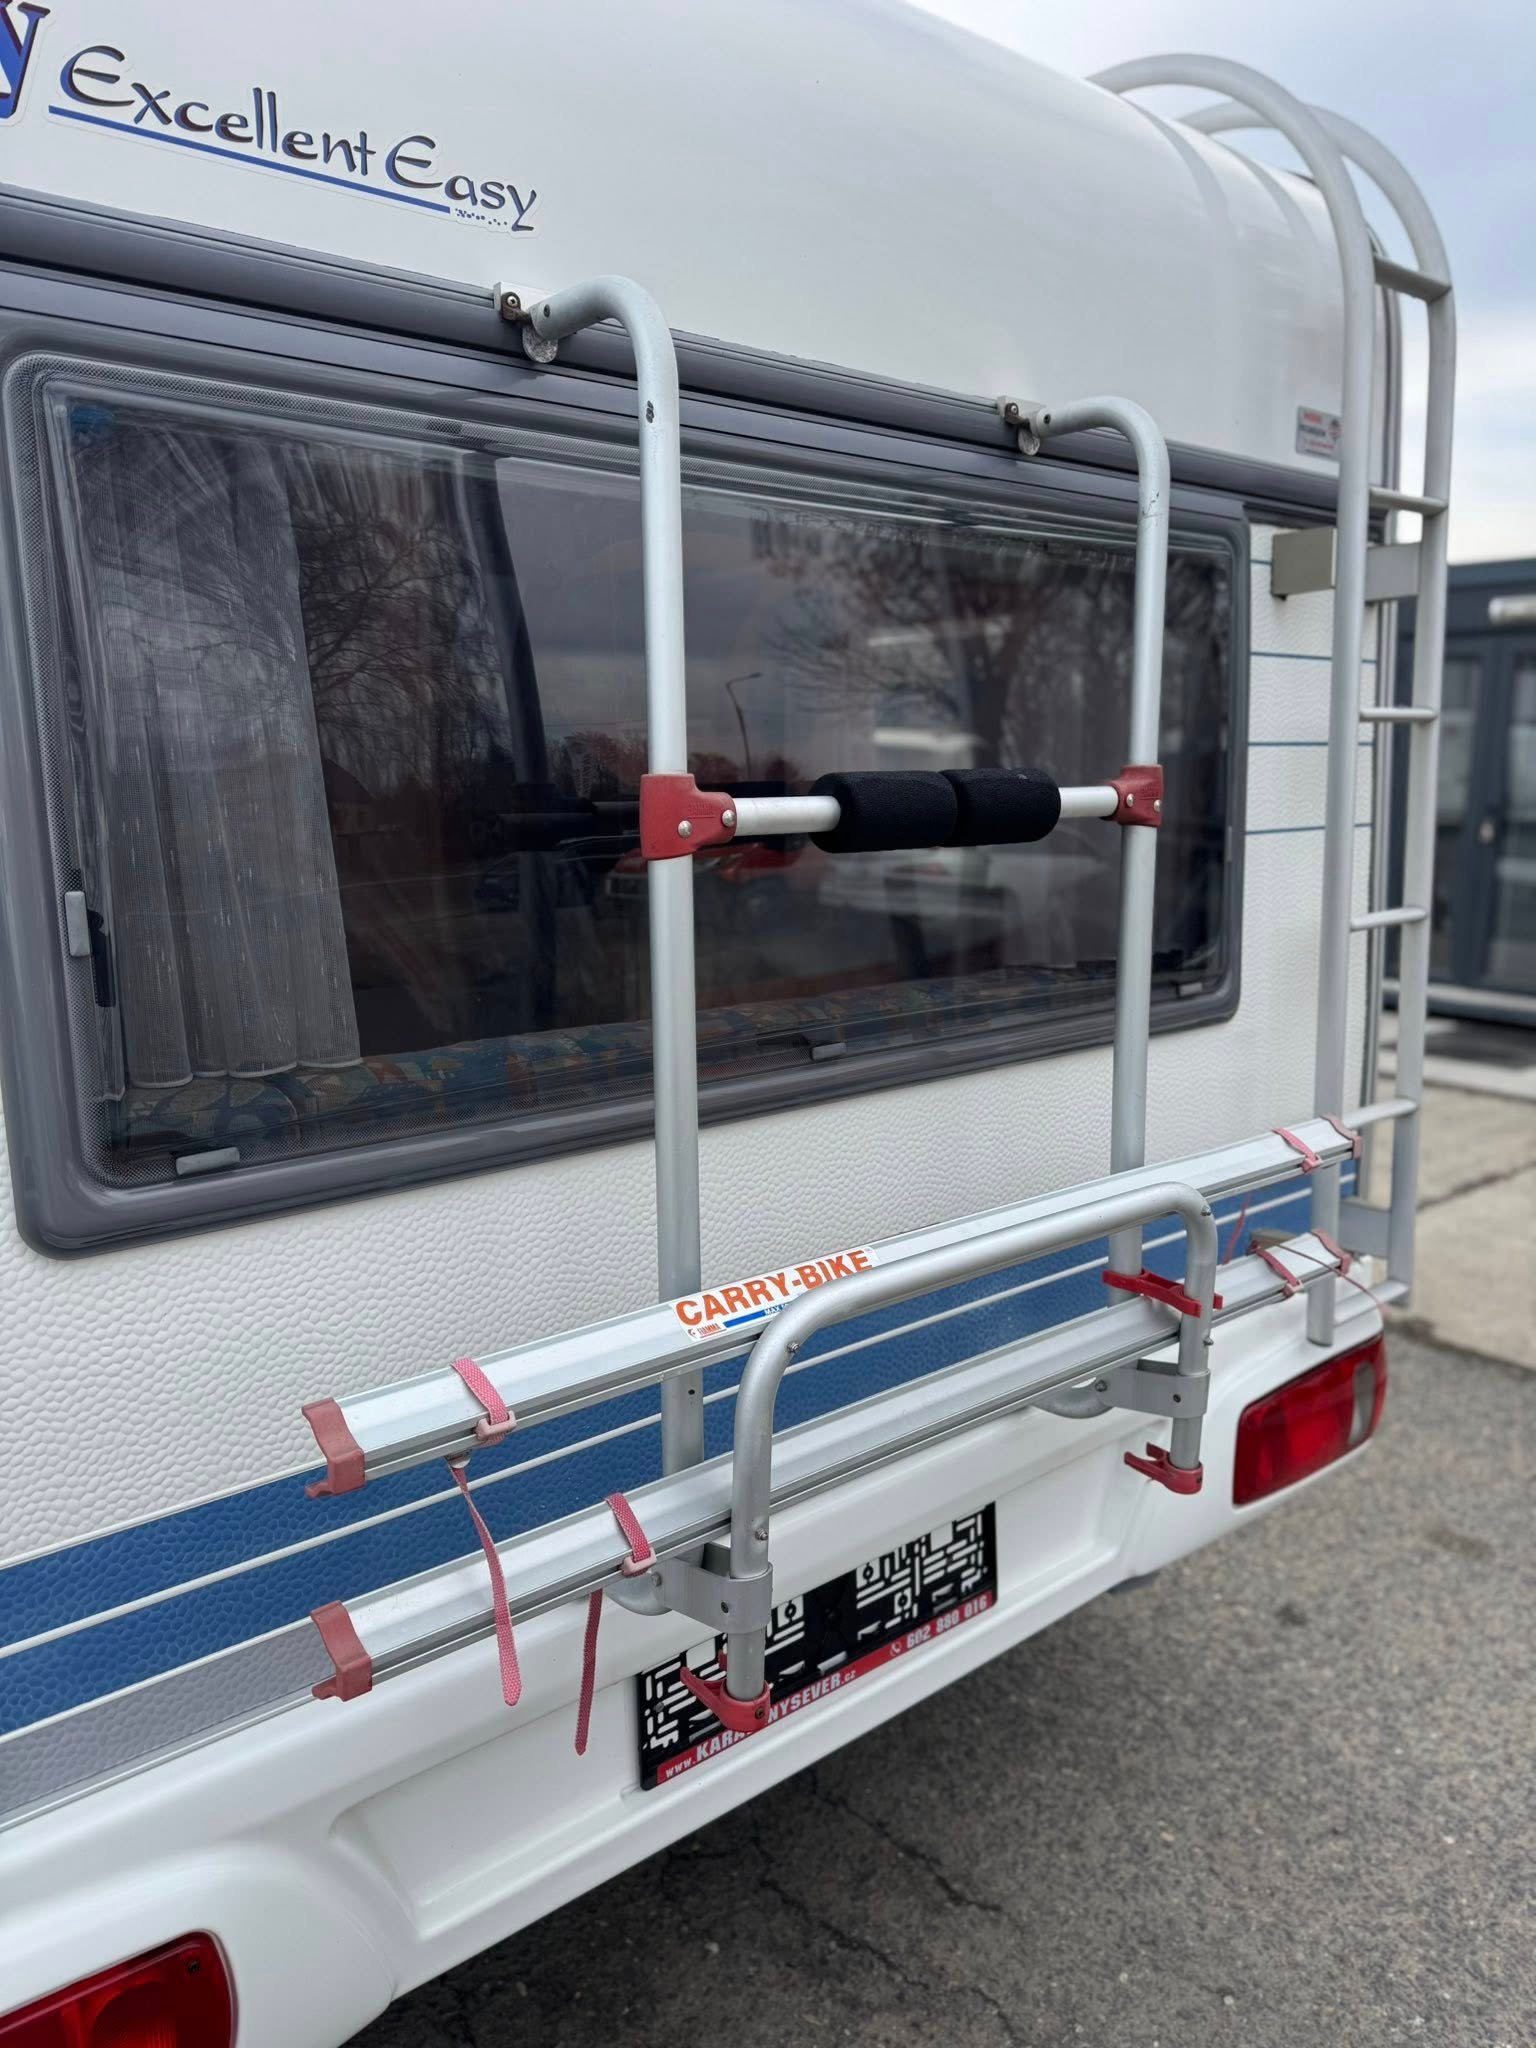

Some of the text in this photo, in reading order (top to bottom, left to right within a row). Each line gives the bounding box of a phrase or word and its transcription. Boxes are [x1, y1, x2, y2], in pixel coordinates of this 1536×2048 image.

[59, 45, 377, 177] Excellent
[385, 135, 538, 232] Easy
[675, 1250, 874, 1326] CARRY-BIKE
[907, 1624, 931, 1649] 602
[936, 1609, 960, 1633] 880
